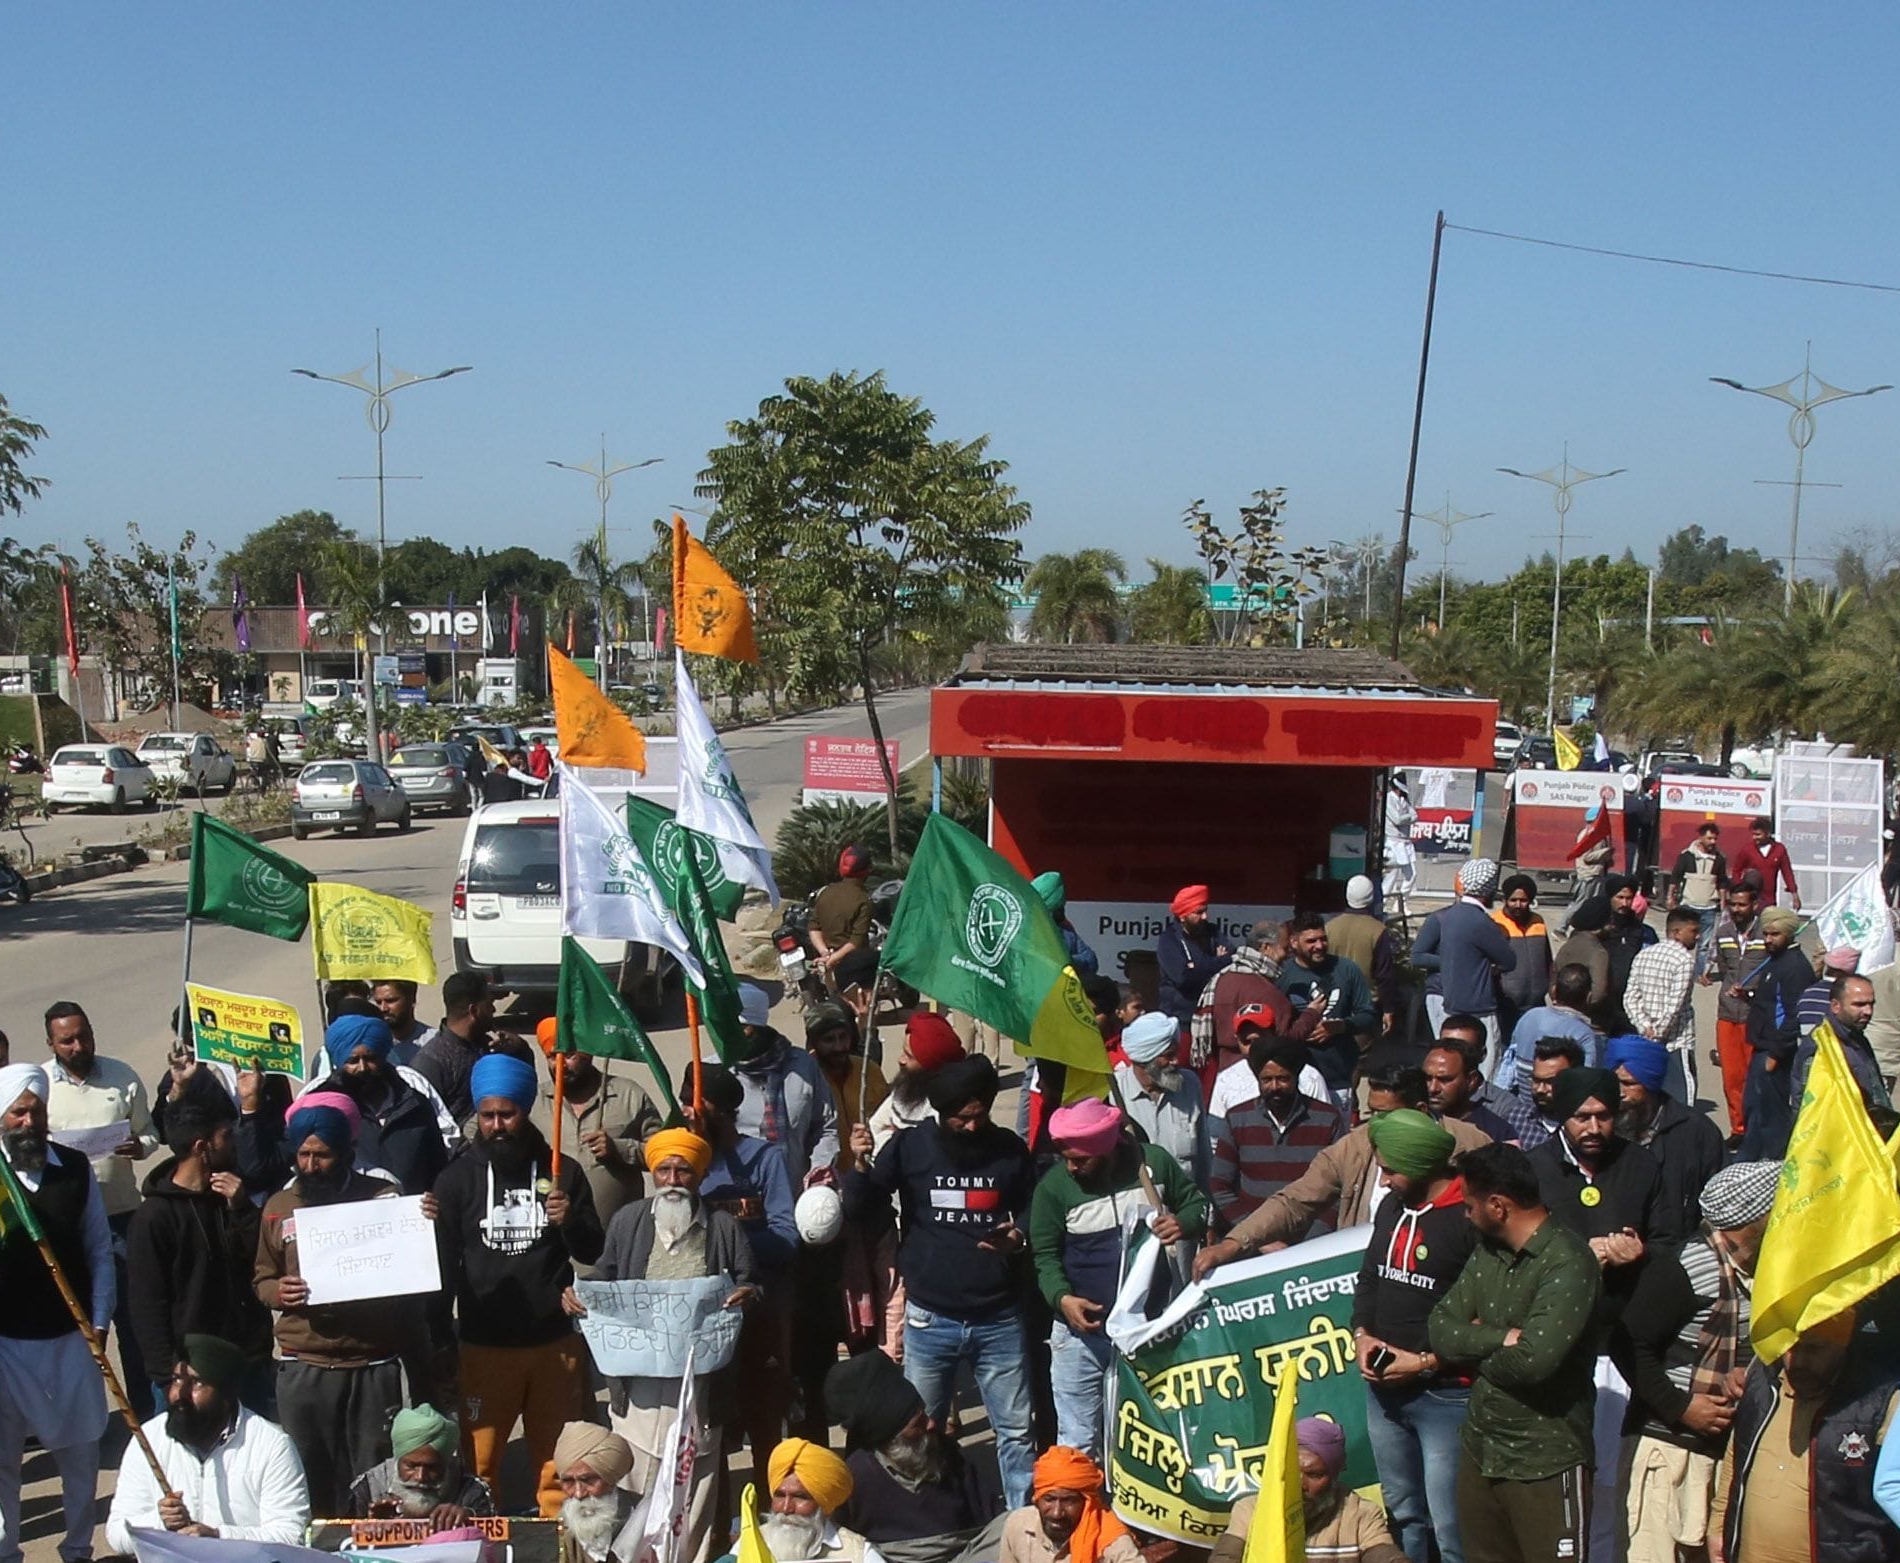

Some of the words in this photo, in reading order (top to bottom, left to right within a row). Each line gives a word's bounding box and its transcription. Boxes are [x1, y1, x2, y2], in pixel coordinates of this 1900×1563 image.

[1544, 780, 1572, 794] Punjab
[1573, 782, 1596, 794] Police
[1549, 791, 1566, 802] SAS
[1567, 792, 1590, 805] Nagar
[1410, 822, 1432, 840] ਜਾਬ
[196, 991, 224, 1009] ਕਿਸਾਨ
[935, 1176, 996, 1189] TOMMY
[934, 1211, 994, 1224] JEANS
[493, 1230, 505, 1240] NO
[1411, 1272, 1436, 1291] CITY
[1282, 1271, 1360, 1311] ਜਿੰਦਾਬਾ
